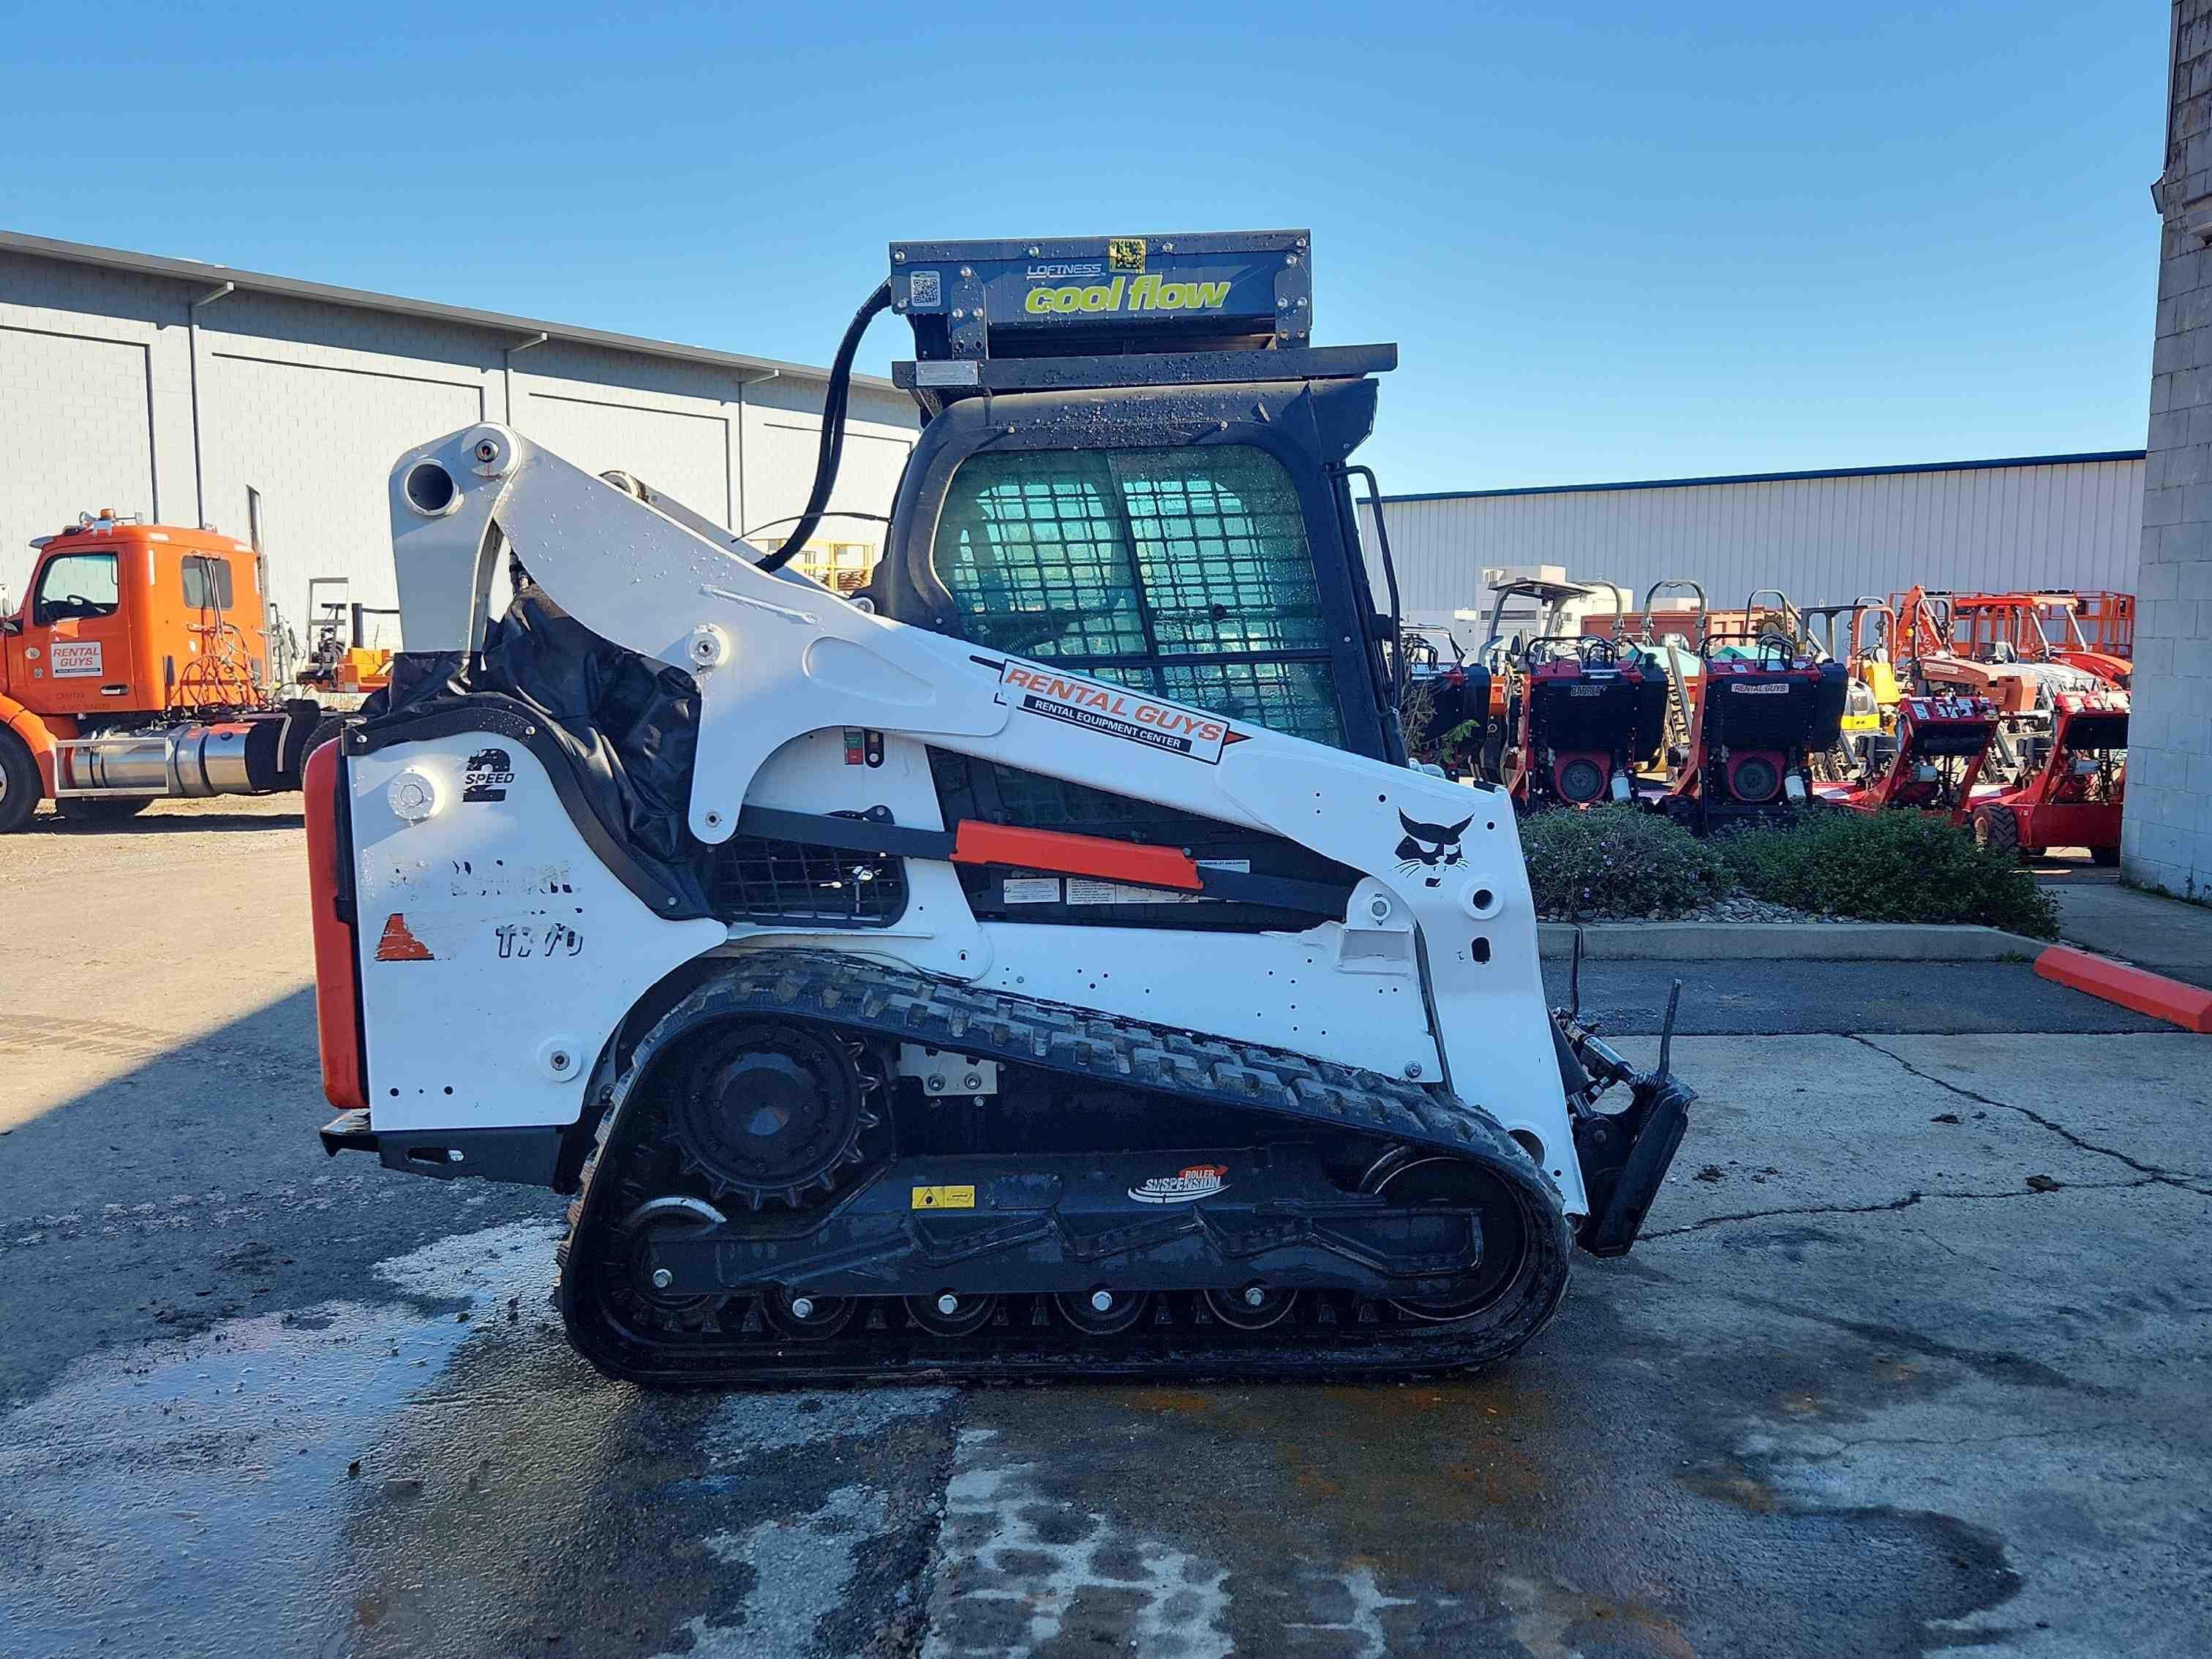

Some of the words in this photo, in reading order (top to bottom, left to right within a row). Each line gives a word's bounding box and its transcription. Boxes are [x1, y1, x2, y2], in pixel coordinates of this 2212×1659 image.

[1027, 263, 1102, 276] LOFTNESS
[1025, 276, 1126, 315] cool
[1128, 274, 1232, 311] flow
[53, 647, 100, 657] RENTAL
[60, 657, 93, 667] GUYS
[1005, 667, 1129, 716] RENTAL
[1135, 704, 1223, 742] GUYS
[1034, 699, 1075, 719] RENTAL
[1076, 710, 1139, 737] EQUIPMENT
[1140, 728, 1181, 748] CENTER
[465, 772, 515, 785] SPEED
[1185, 1170, 1215, 1178] ROLLER
[1145, 1175, 1222, 1191] SUSPENSION
